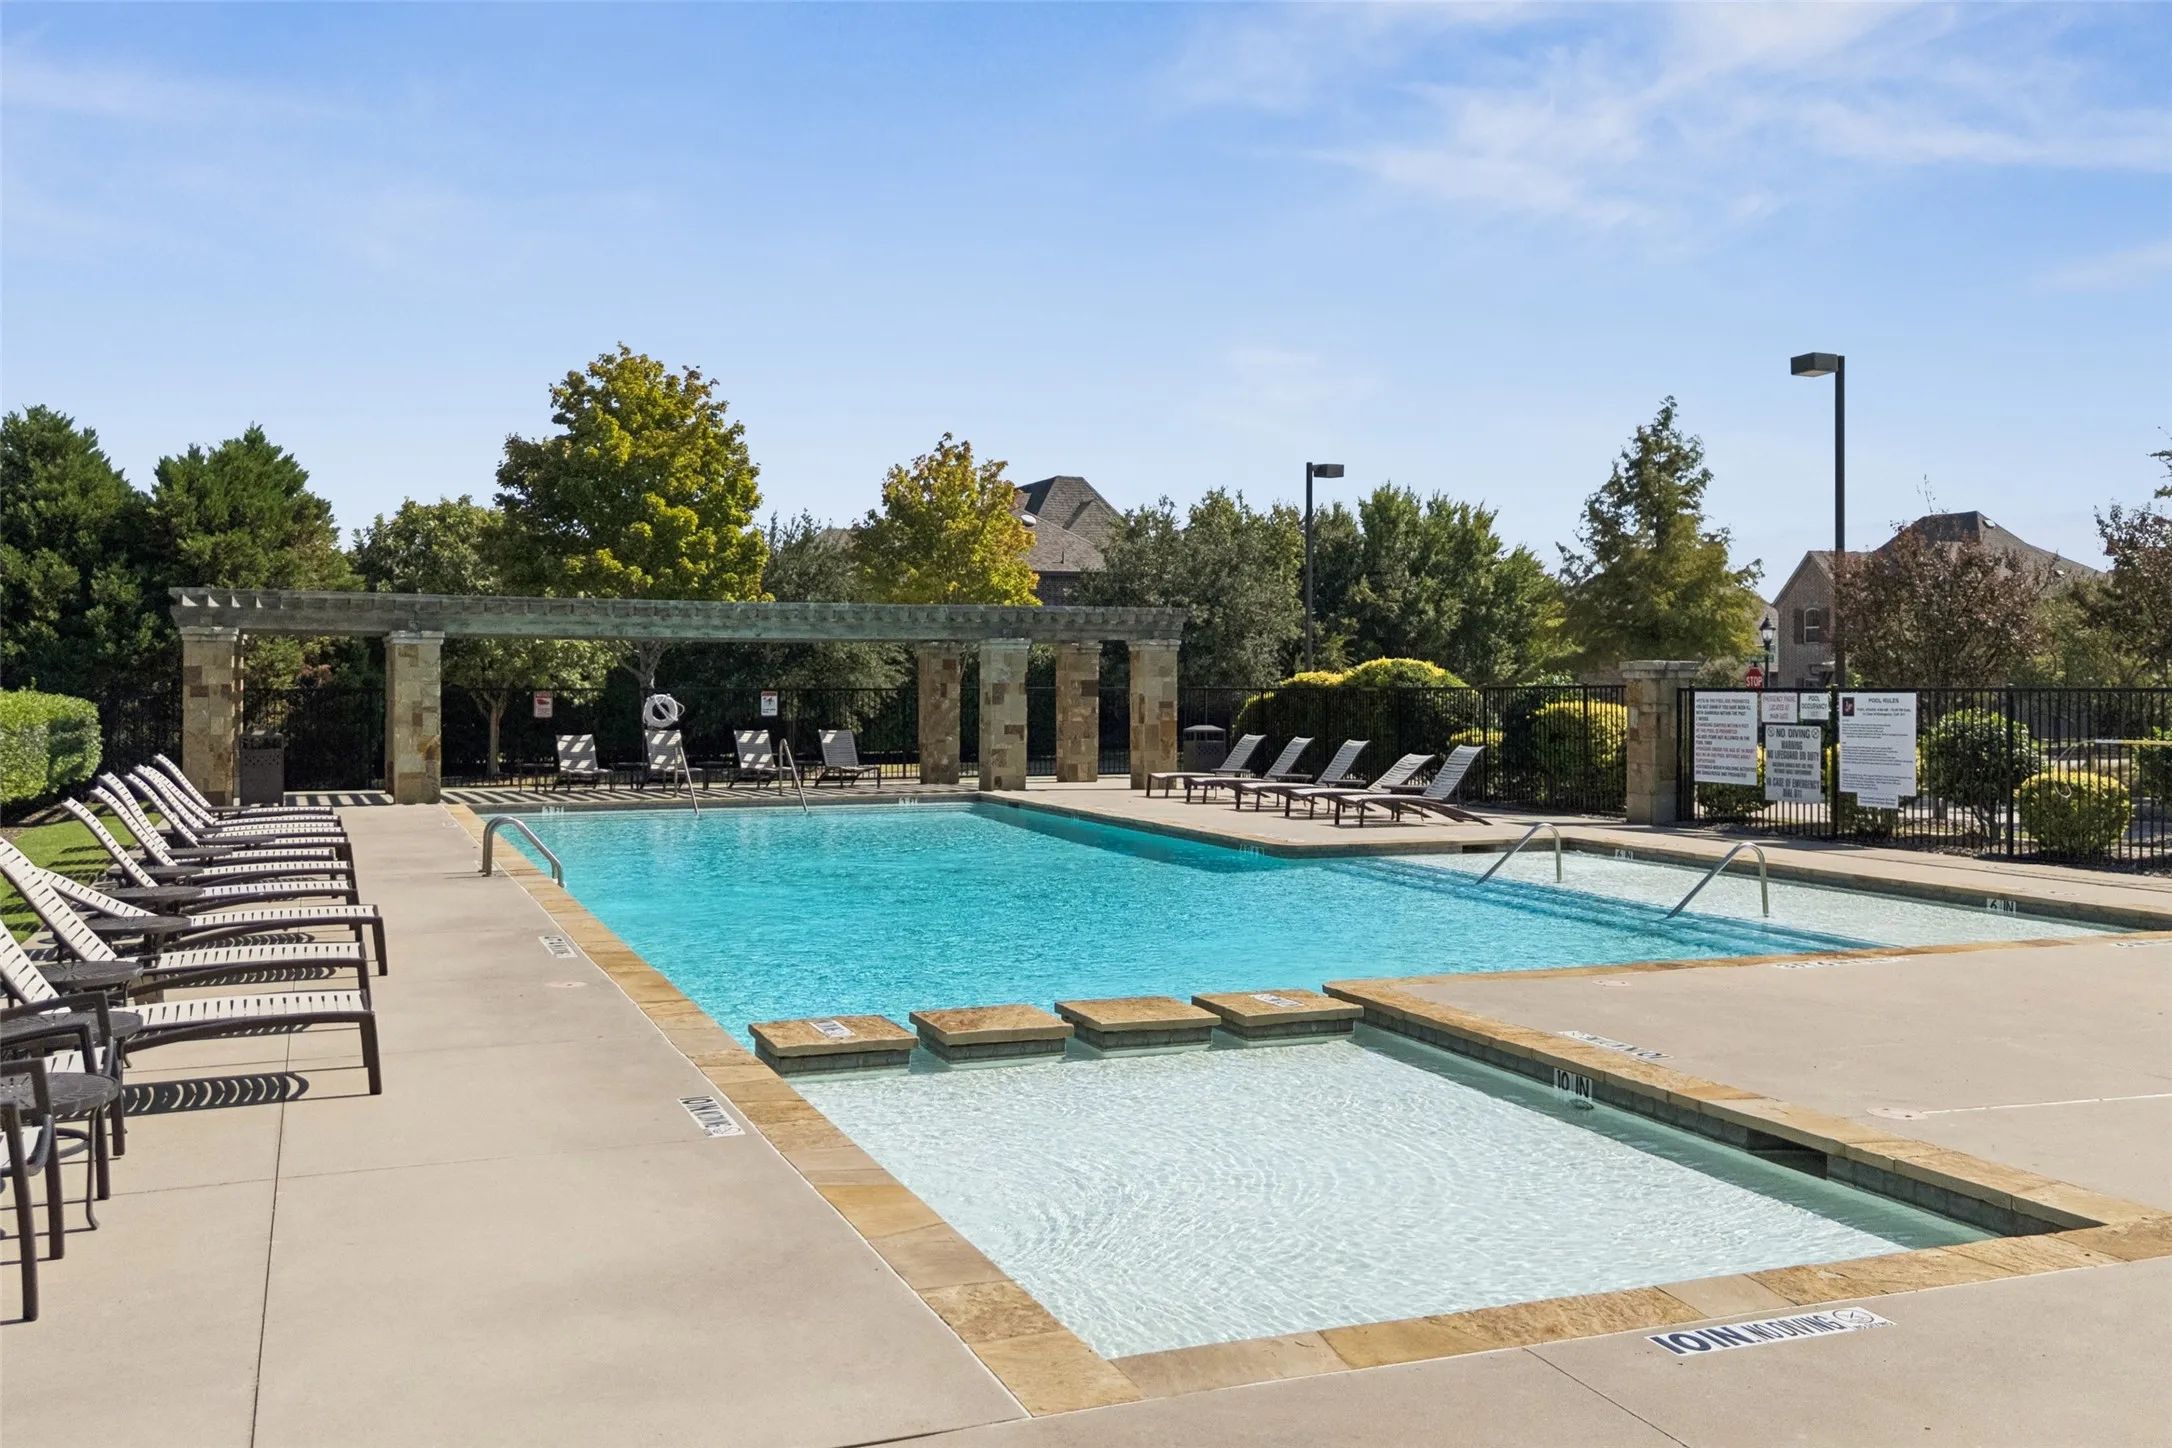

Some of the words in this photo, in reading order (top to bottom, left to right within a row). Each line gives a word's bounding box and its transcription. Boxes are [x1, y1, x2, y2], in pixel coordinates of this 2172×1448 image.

[1746, 676, 1762, 686] STOP
[1776, 728, 1785, 738] NO
[1788, 729, 1810, 738] DIVING
[1775, 750, 1798, 760] LIFEGUARD
[1807, 752, 1819, 761] DUTY
[1792, 779, 1819, 789] EMERGENCY
[1990, 900, 1997, 909] 6
[2004, 900, 2014, 912] IN
[1557, 1070, 1569, 1090] 10
[1576, 1076, 1589, 1098] IN
[1650, 1333, 1712, 1354] 10
[1742, 1324, 1778, 1342] NO
[1776, 1315, 1844, 1338] DIVING
